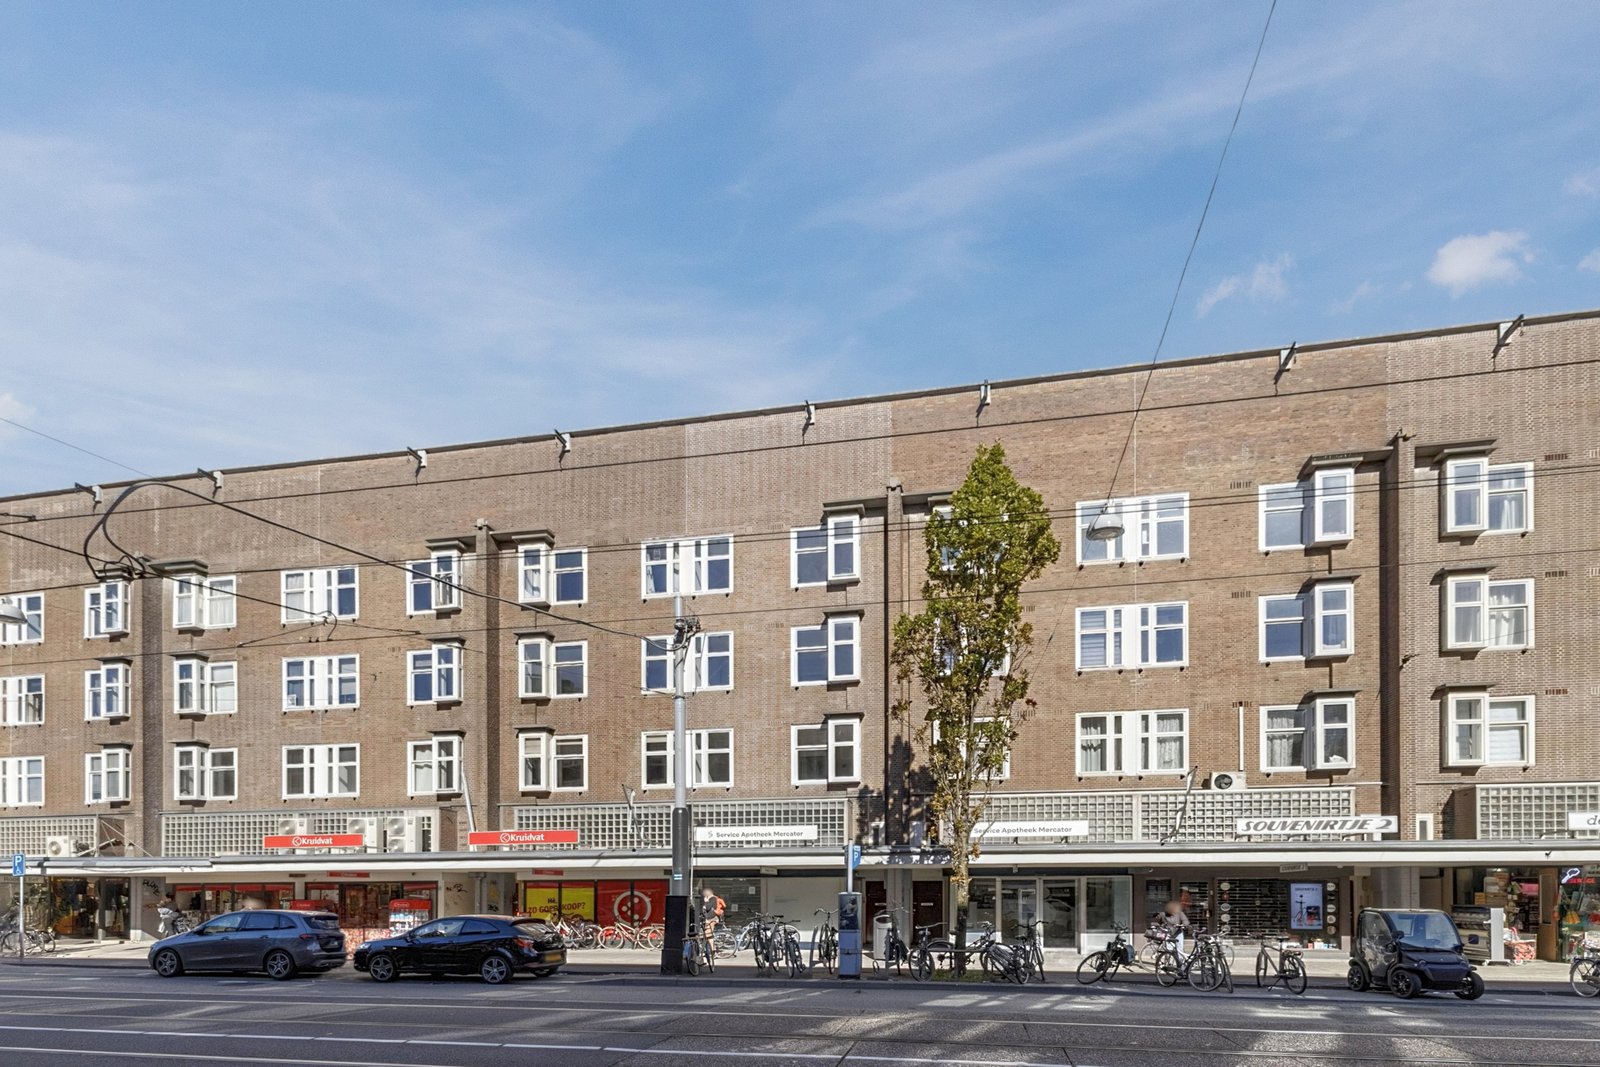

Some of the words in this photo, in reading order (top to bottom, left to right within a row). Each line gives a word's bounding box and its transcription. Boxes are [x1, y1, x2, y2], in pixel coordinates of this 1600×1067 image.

[1241, 819, 1373, 832] SOUVENIRTJE
[1376, 819, 1392, 830] 2
[740, 831, 772, 839] Apotheek
[1002, 827, 1037, 835] Apotheek
[301, 837, 333, 845] Kruidvat
[510, 834, 545, 842] Kruidvat
[854, 851, 859, 861] P
[15, 856, 22, 867] P
